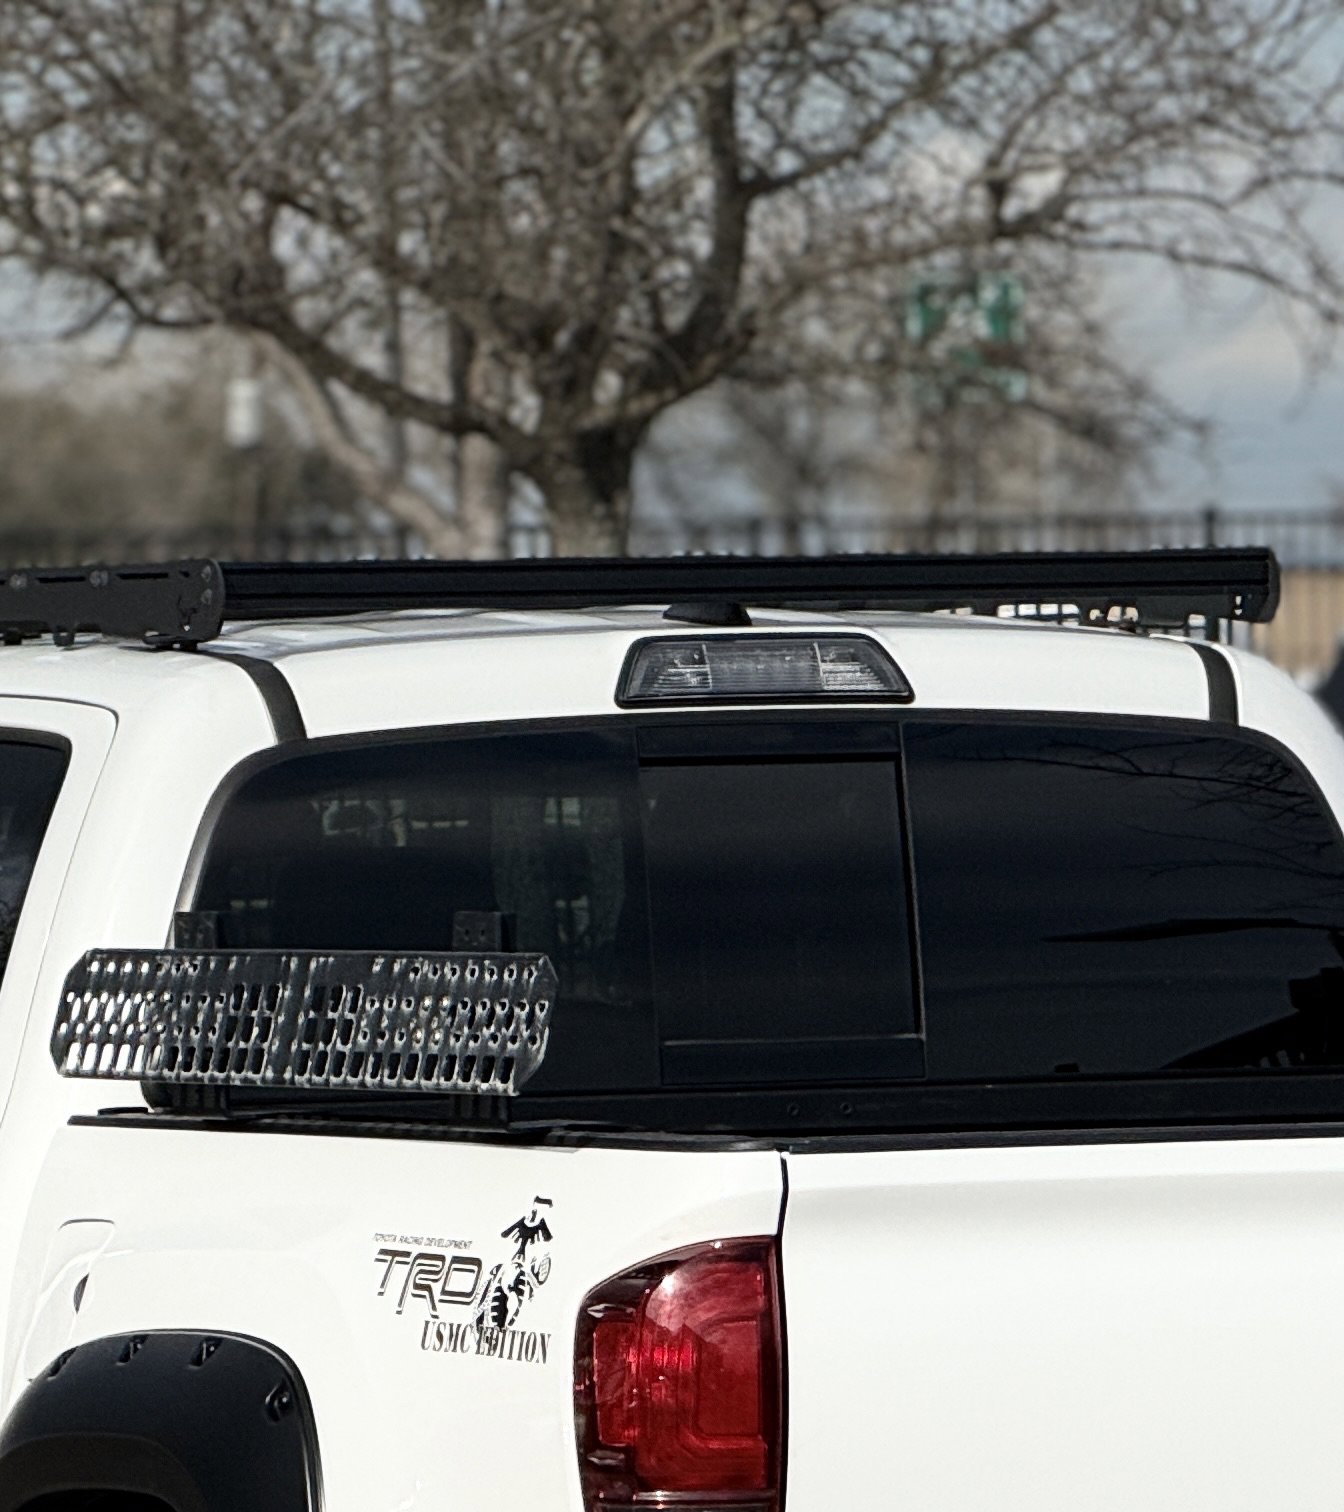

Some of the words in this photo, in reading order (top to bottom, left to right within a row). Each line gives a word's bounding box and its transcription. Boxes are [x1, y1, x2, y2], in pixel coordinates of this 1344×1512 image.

[374, 1248, 483, 1319] TRD
[420, 1320, 473, 1354] USMC
[474, 1325, 552, 1364] EDITION
